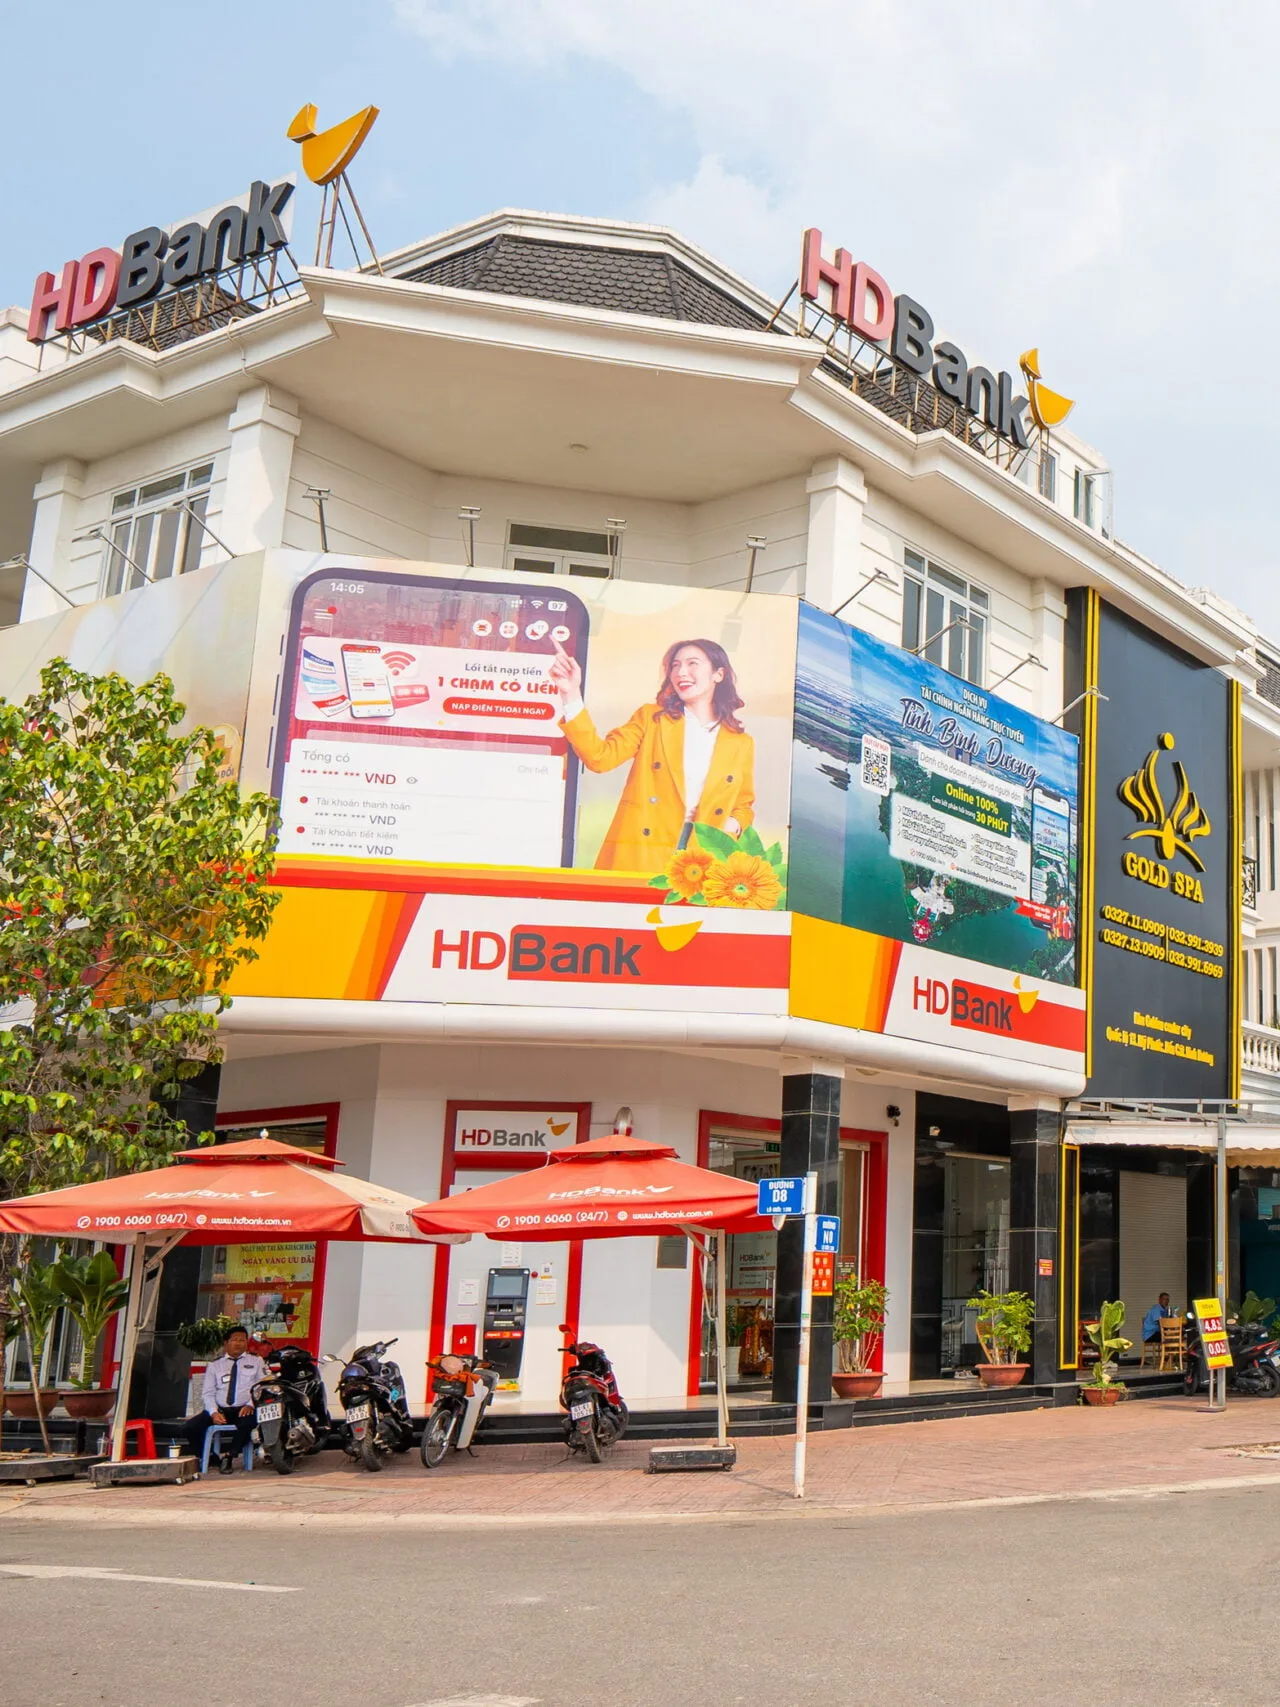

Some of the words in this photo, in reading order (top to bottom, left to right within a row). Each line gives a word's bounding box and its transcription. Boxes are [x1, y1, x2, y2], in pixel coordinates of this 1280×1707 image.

[27, 180, 295, 344] HDBank
[801, 228, 1029, 450] HDBank
[330, 582, 364, 594] 14:05
[438, 676, 444, 688] 1
[450, 678, 494, 692] CHẠM
[500, 678, 522, 692] CÓ
[522, 706, 546, 716] NGAY
[335, 752, 350, 764] có
[938, 718, 980, 756] Bình
[986, 737, 1040, 788] Dương
[364, 772, 397, 785] VND
[945, 783, 974, 805] Online
[975, 796, 999, 815] 100%
[369, 814, 397, 826] VND
[976, 810, 986, 825] 30
[986, 814, 1009, 833] PHÚT
[366, 844, 394, 856] VND
[1122, 852, 1170, 888] GOLD
[1171, 872, 1204, 904] SPA
[1102, 905, 1166, 938] 0327.11.0909
[431, 925, 643, 978] HDBank
[1102, 928, 1166, 960] 0327.13.0909
[913, 975, 1012, 1031] HDBank
[461, 1128, 546, 1147] HDBank
[548, 1185, 645, 1200] HDBank
[772, 1188, 788, 1203] D8
[94, 1216, 121, 1227] 1900
[124, 1214, 152, 1226] 6060
[155, 1212, 188, 1225] (24/7)
[211, 1215, 292, 1226] www.hdbank.com.vn
[514, 1214, 540, 1226] 1900
[544, 1213, 572, 1224] 6060
[576, 1210, 608, 1224] (24/7)
[632, 1210, 714, 1220] www.hdbank.com.vn
[740, 1254, 764, 1262] HDBank
